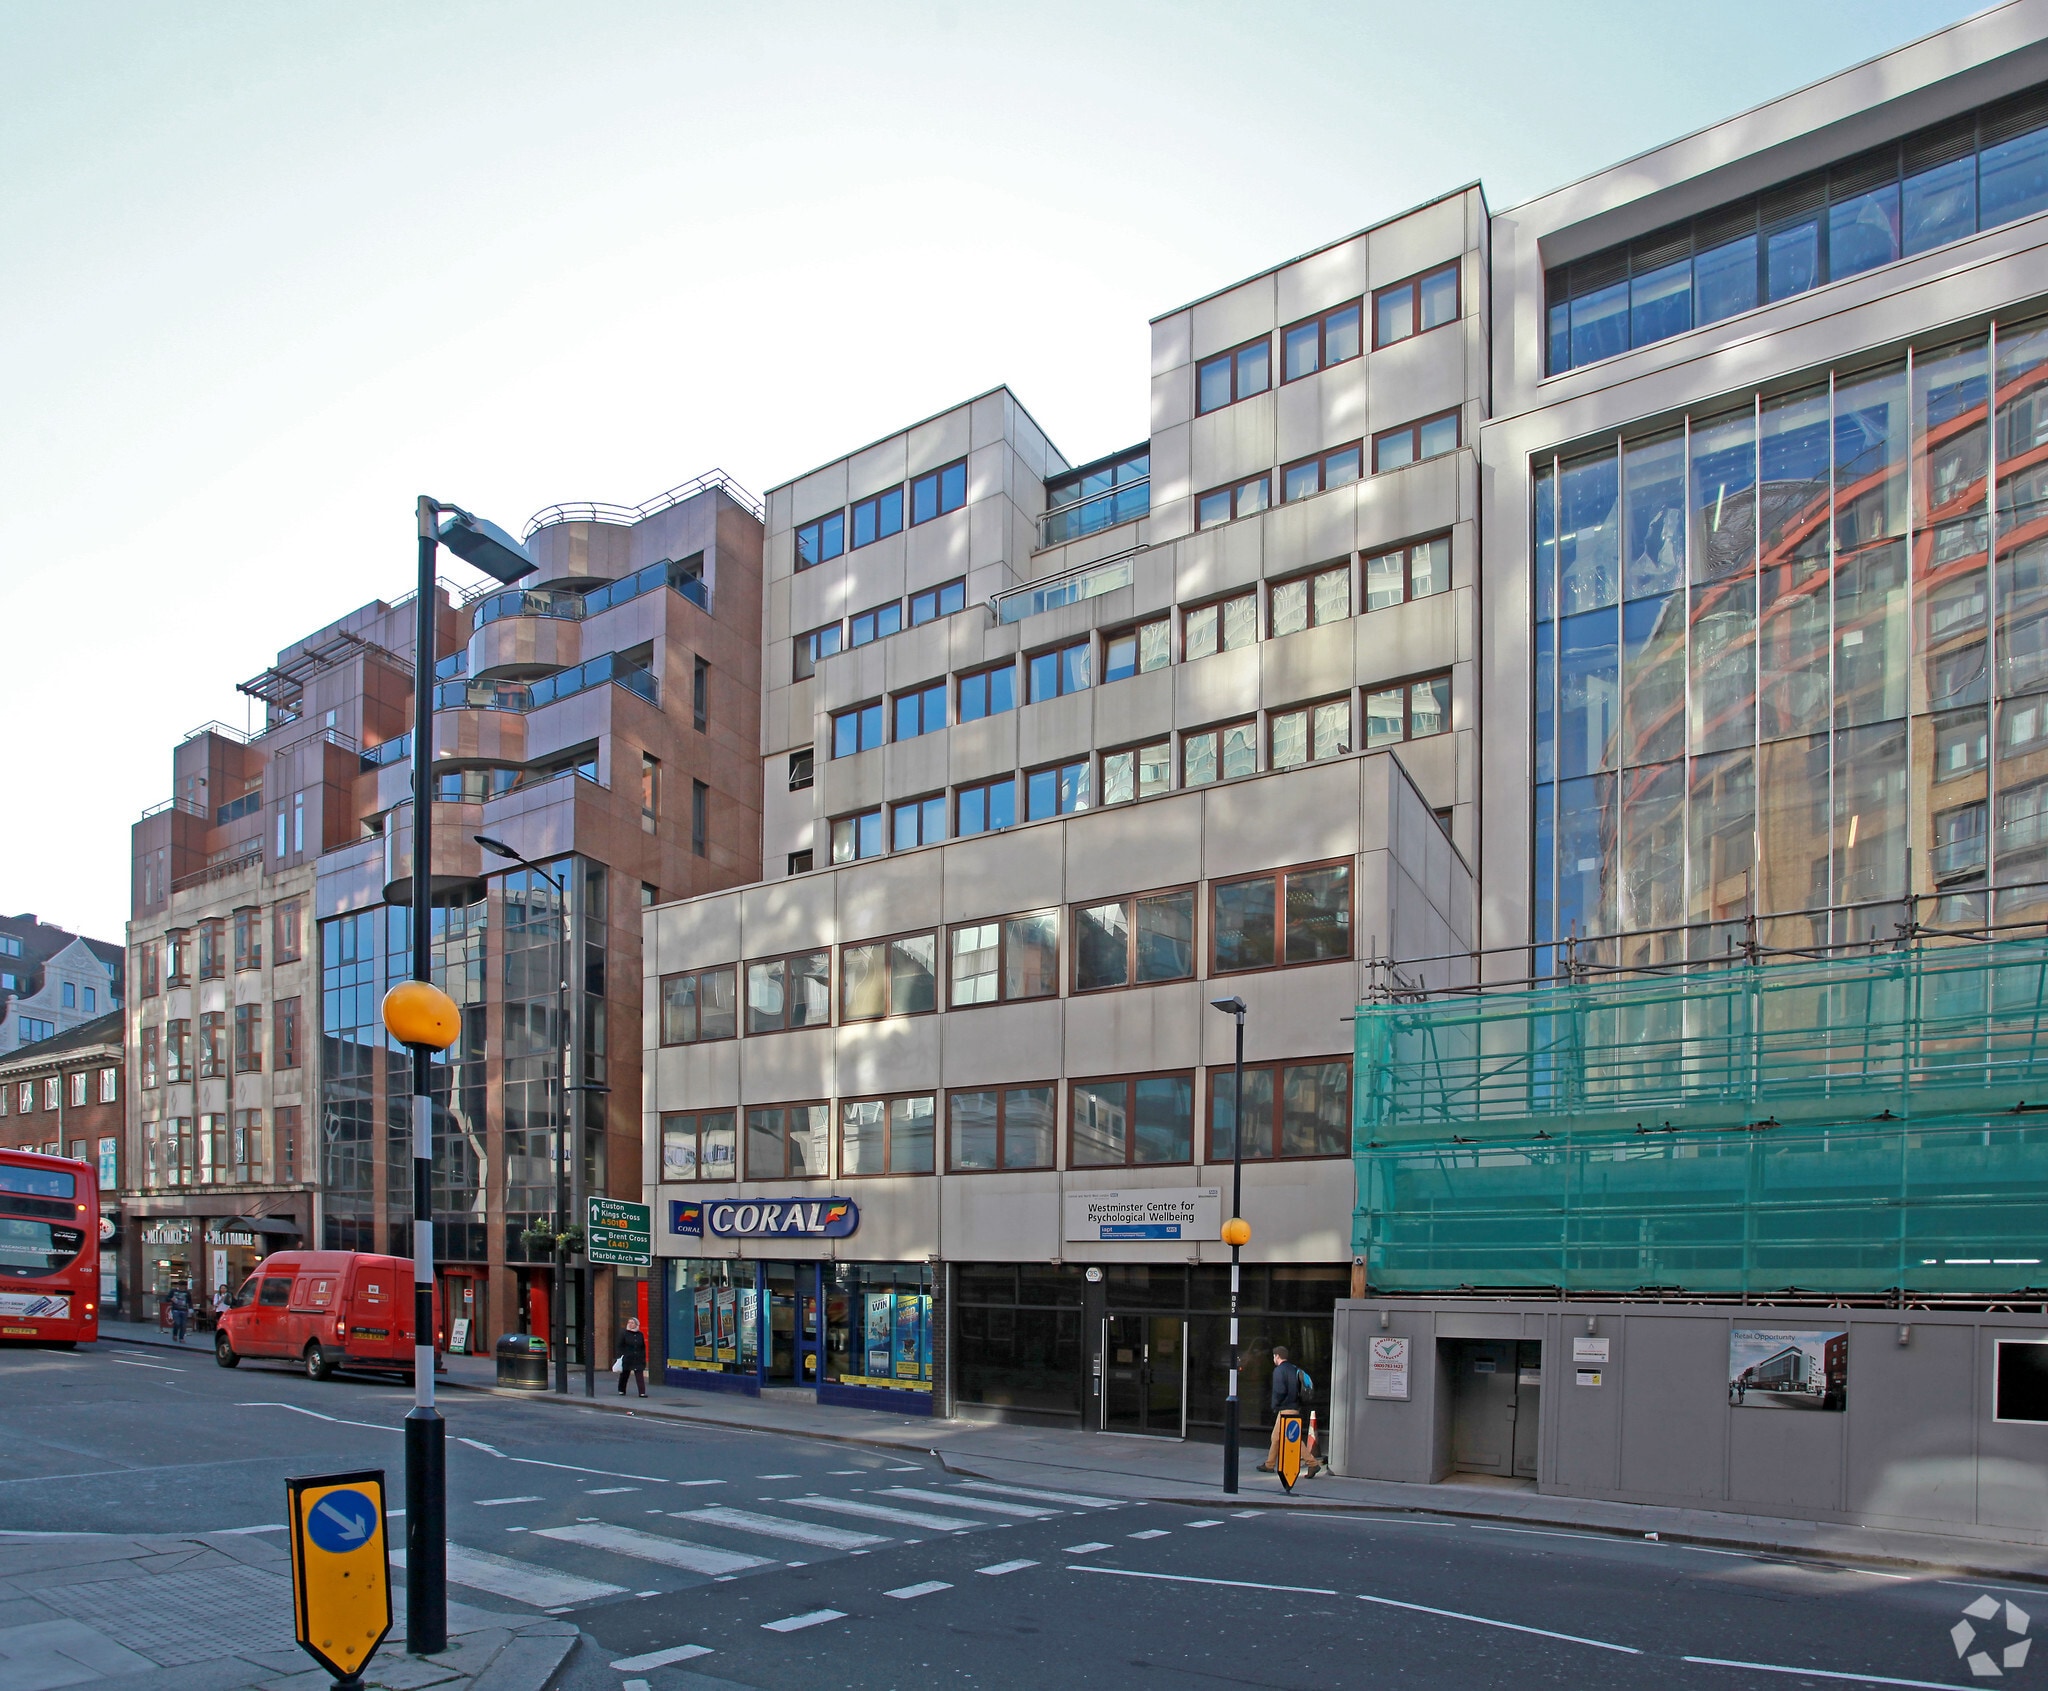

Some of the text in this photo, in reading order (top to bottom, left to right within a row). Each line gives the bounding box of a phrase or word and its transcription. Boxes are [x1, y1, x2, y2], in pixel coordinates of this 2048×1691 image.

[101, 1139, 116, 1153] NHS
[601, 1201, 624, 1210] Euston
[1088, 1201, 1195, 1212] Westminster Centre for
[601, 1210, 640, 1221] Kings Cross
[712, 1203, 826, 1233] CORAL
[1088, 1212, 1195, 1223] Psychological Wellbeing
[601, 1218, 619, 1226] A501
[608, 1232, 648, 1243] Brent Cross
[608, 1240, 629, 1249] (A41)
[592, 1251, 616, 1260] Marble
[872, 1300, 887, 1311] WIN
[1754, 1333, 1796, 1341] Opportunity
